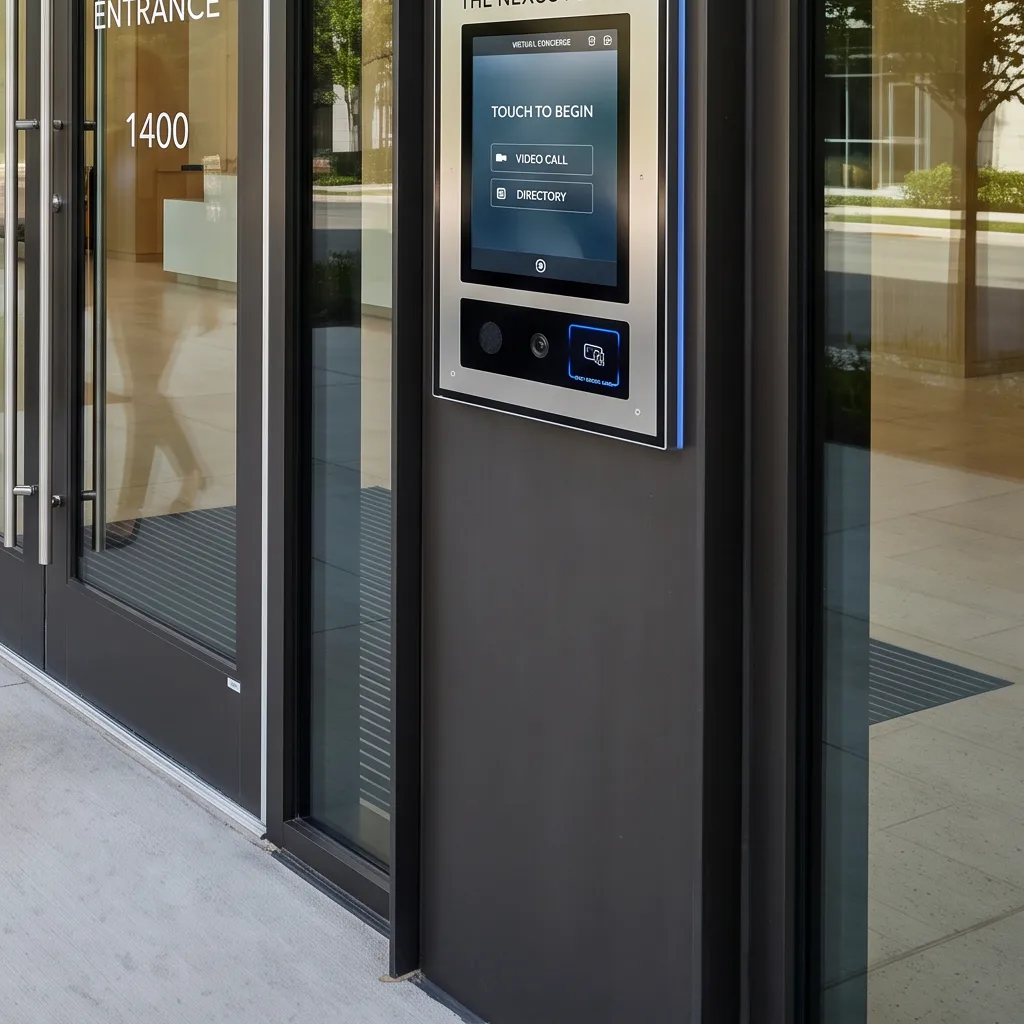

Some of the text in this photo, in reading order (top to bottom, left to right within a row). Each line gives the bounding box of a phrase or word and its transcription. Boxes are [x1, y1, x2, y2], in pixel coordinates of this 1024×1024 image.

[491, 104, 593, 118] TOUCH TO BEGIN
[125, 111, 189, 150] 1400
[516, 153, 568, 166] VIDEO CALL
[516, 189, 567, 202] DIRECTORY
